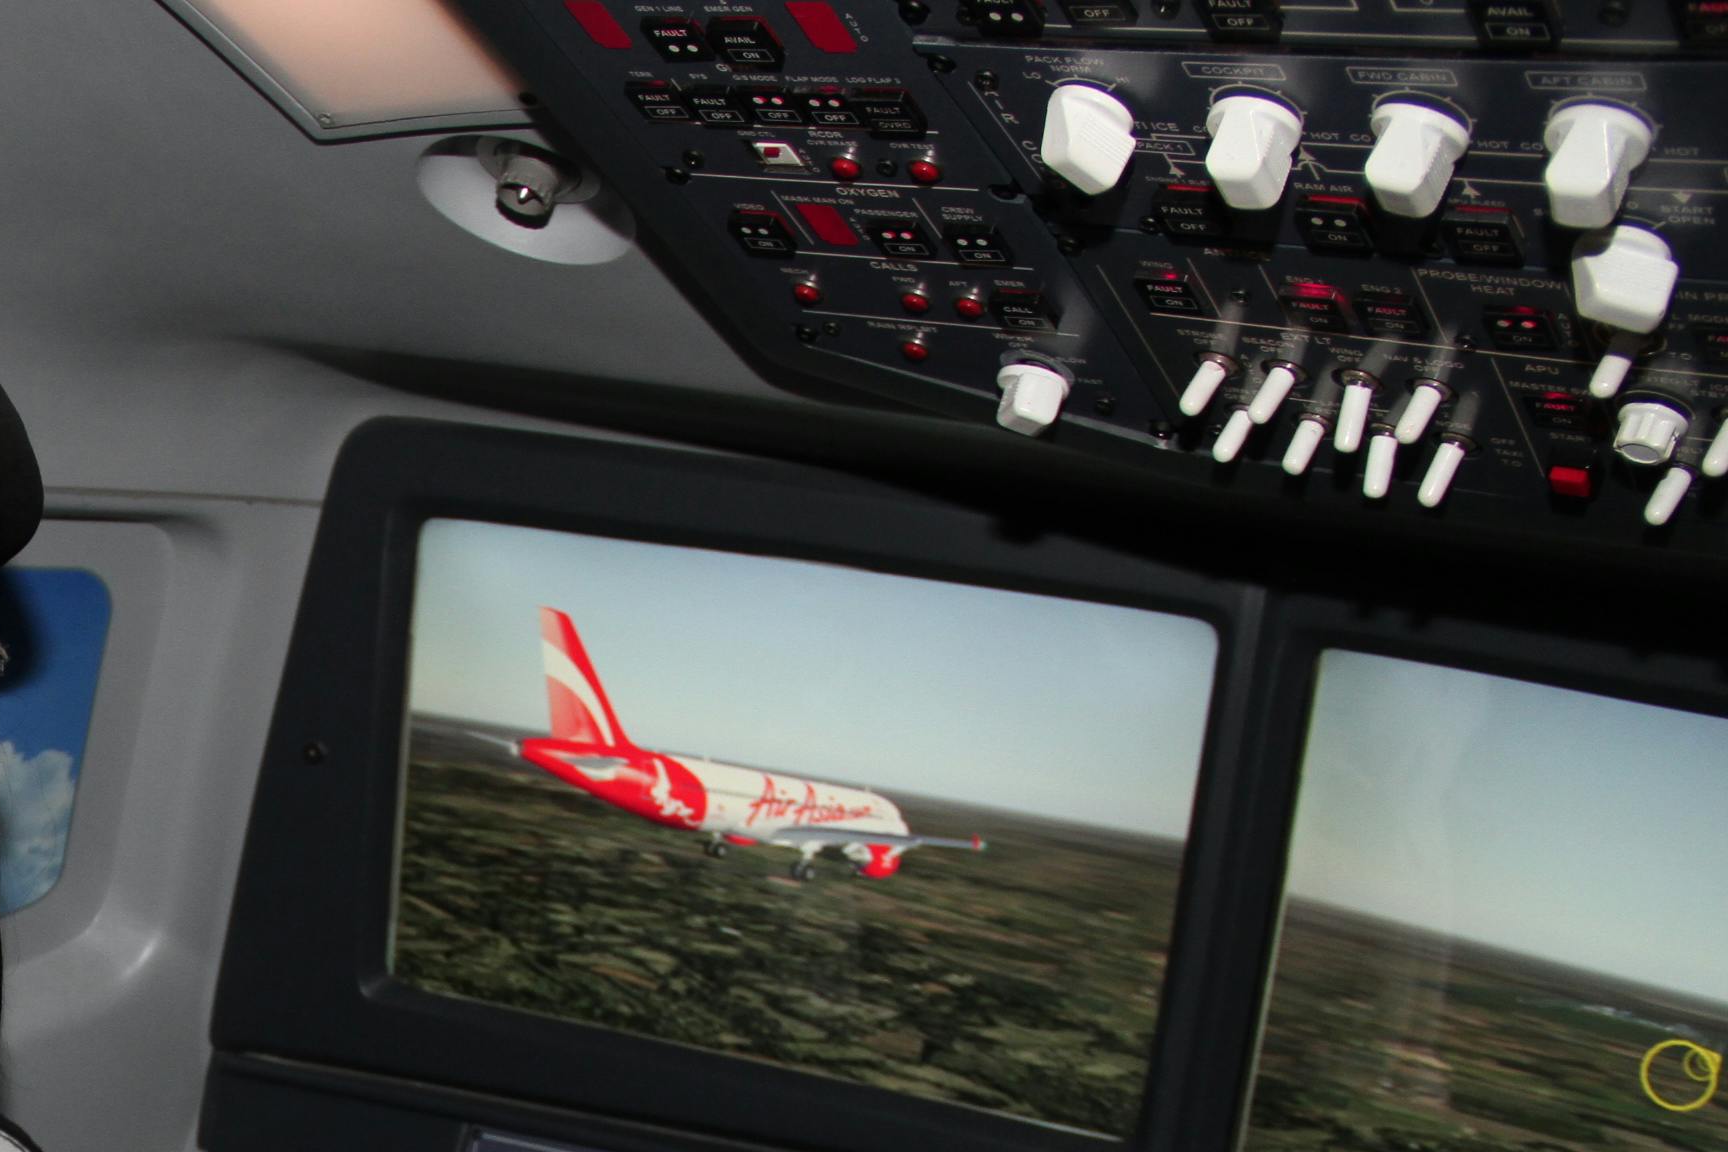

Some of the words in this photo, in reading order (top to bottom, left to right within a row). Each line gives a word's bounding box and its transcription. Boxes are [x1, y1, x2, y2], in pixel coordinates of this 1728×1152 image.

[1083, 8, 1112, 18] OFF
[1487, 6, 1534, 17] AVAIL
[1226, 17, 1255, 27] OFF
[653, 29, 689, 38] FAULT
[1505, 26, 1532, 37] ON
[723, 35, 757, 45] AVAIL
[742, 51, 760, 60] ON
[1024, 55, 1063, 65] PACK
[1050, 65, 1092, 75] NORM
[1200, 65, 1264, 77] COCKPIT
[1357, 71, 1393, 81] FWD
[1396, 71, 1447, 82] CABIN
[1540, 76, 1572, 86] AFT
[1576, 76, 1633, 87] CABIN
[637, 94, 672, 103] FAULT
[692, 97, 727, 107] FAULT
[656, 108, 677, 116] OFF
[711, 111, 733, 120] OFF
[767, 111, 789, 120] OFF
[865, 106, 901, 117] FAULT
[824, 114, 847, 123] OFF
[1151, 121, 1181, 133] ICE
[1310, 132, 1340, 142] HOT
[1476, 140, 1511, 150] HOT
[835, 186, 900, 199] OXYGEN
[1293, 182, 1327, 192] RAM
[1329, 185, 1355, 194] AIR
[853, 208, 920, 219] PASSENGER
[1160, 206, 1206, 217] FAULT
[942, 213, 984, 223] SUPPLY
[1667, 215, 1716, 226] OPEN
[1179, 222, 1209, 232] OFF
[1456, 227, 1501, 238] FAULT
[1327, 233, 1349, 243] ON
[757, 239, 775, 248] ON
[898, 244, 917, 253] ON
[973, 251, 993, 260] ON
[869, 261, 919, 273] CALLS
[1416, 267, 1564, 291] PROBE/WINDOW
[1145, 284, 1185, 294] FAULT
[1470, 283, 1516, 297] HEAT
[1002, 305, 1034, 315] CALL
[1290, 301, 1330, 312] FAULT
[1366, 306, 1408, 317] FAULT
[1018, 318, 1036, 326] ON
[1523, 364, 1561, 376] APU
